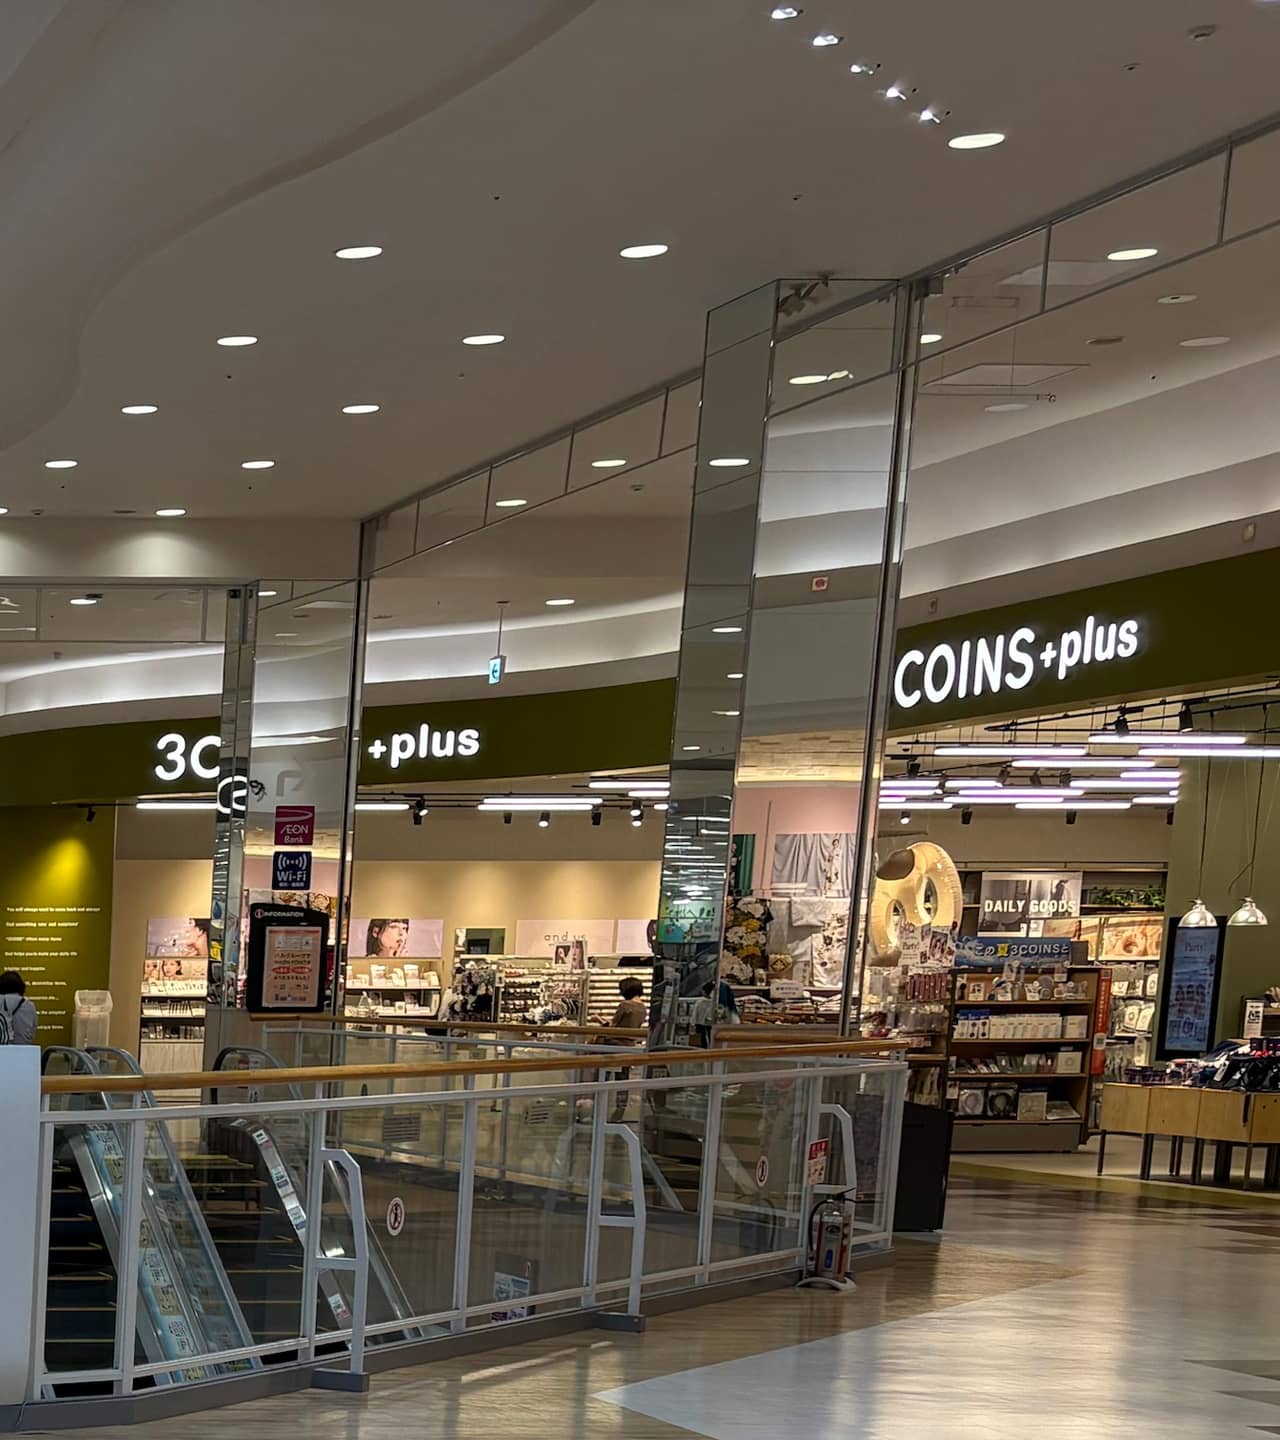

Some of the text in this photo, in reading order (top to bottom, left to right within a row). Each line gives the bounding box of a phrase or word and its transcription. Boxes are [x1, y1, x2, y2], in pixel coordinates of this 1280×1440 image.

[283, 835, 304, 844] Bank
[276, 870, 307, 881] Wi-Fi
[984, 900, 1077, 913] DAILY GOODS
[544, 931, 569, 941] and
